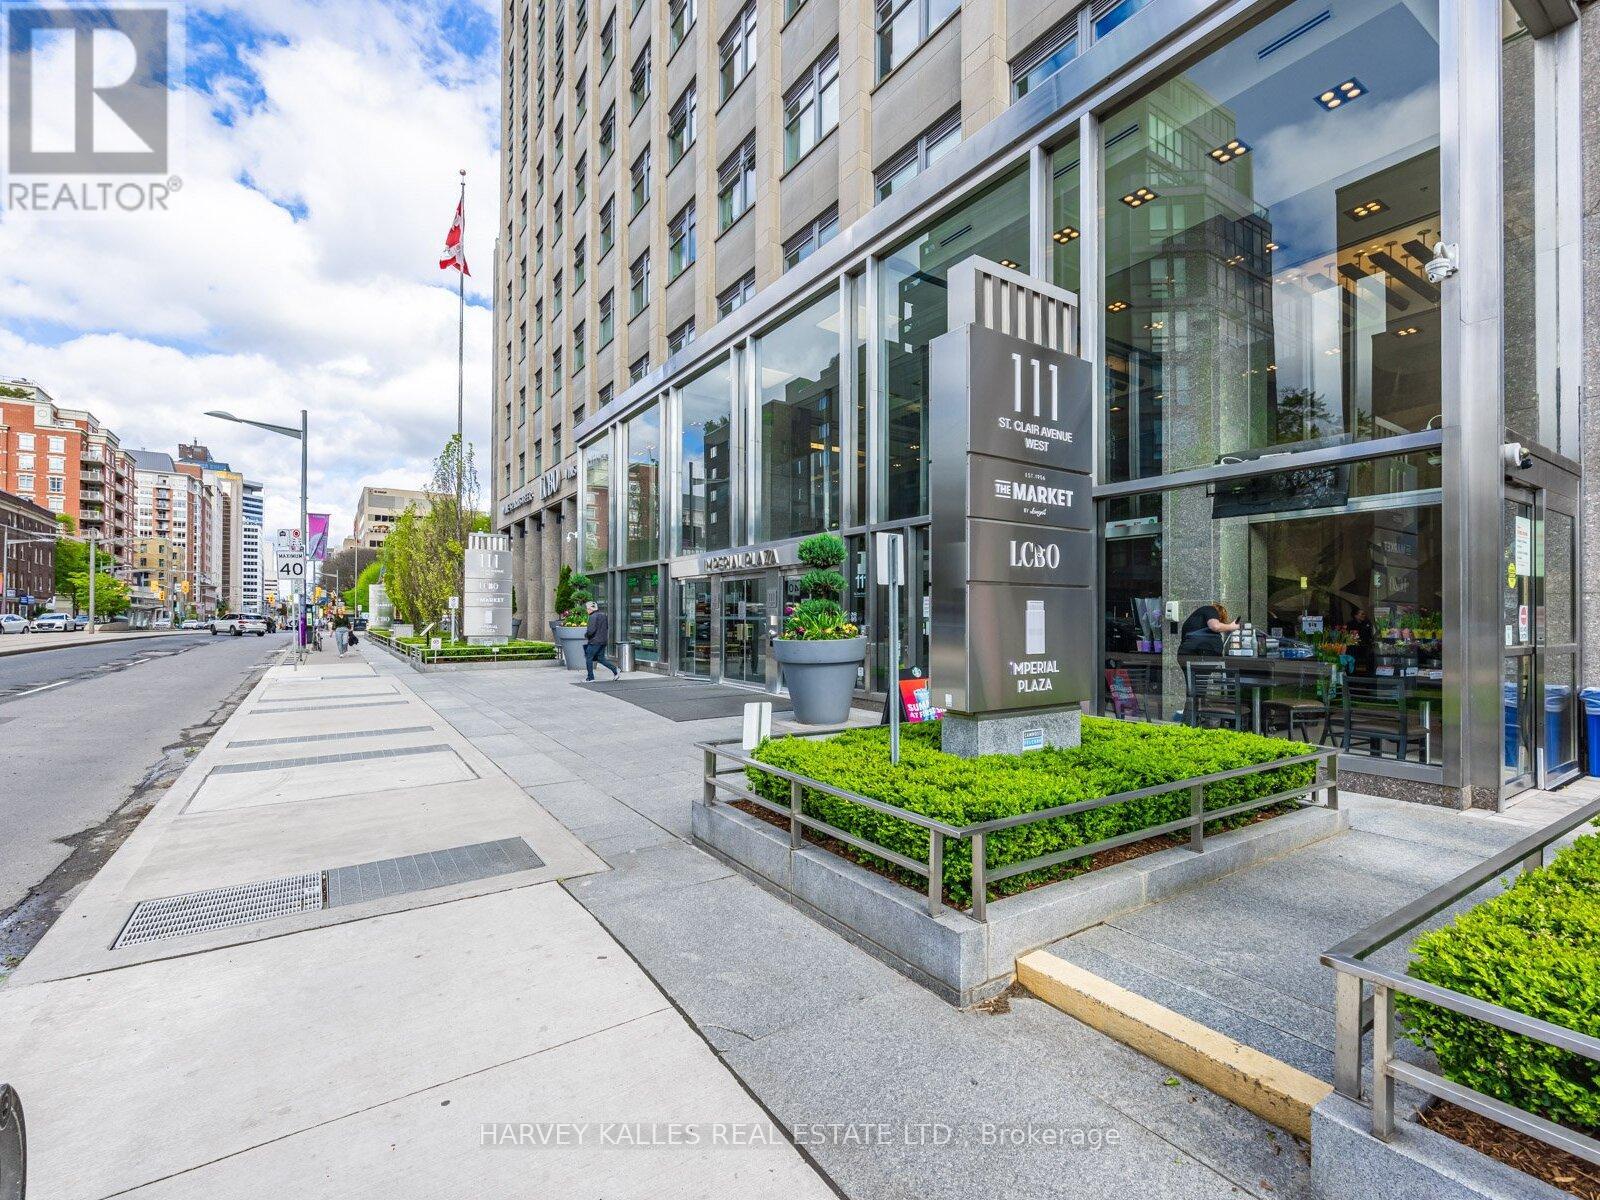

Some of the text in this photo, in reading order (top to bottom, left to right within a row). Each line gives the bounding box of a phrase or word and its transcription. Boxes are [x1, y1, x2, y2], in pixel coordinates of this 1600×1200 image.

[1011, 352, 1058, 421] 111
[998, 417, 1073, 443] ST. CLAIR AVENUE
[1024, 437, 1049, 452] WEST
[995, 481, 1074, 507] THE MARKET
[744, 548, 779, 567] PLAZA
[1009, 540, 1060, 569] LCBO
[280, 562, 303, 576] 40
[1009, 660, 1060, 676] IMPERIAL
[1017, 678, 1052, 693] PLAZA
